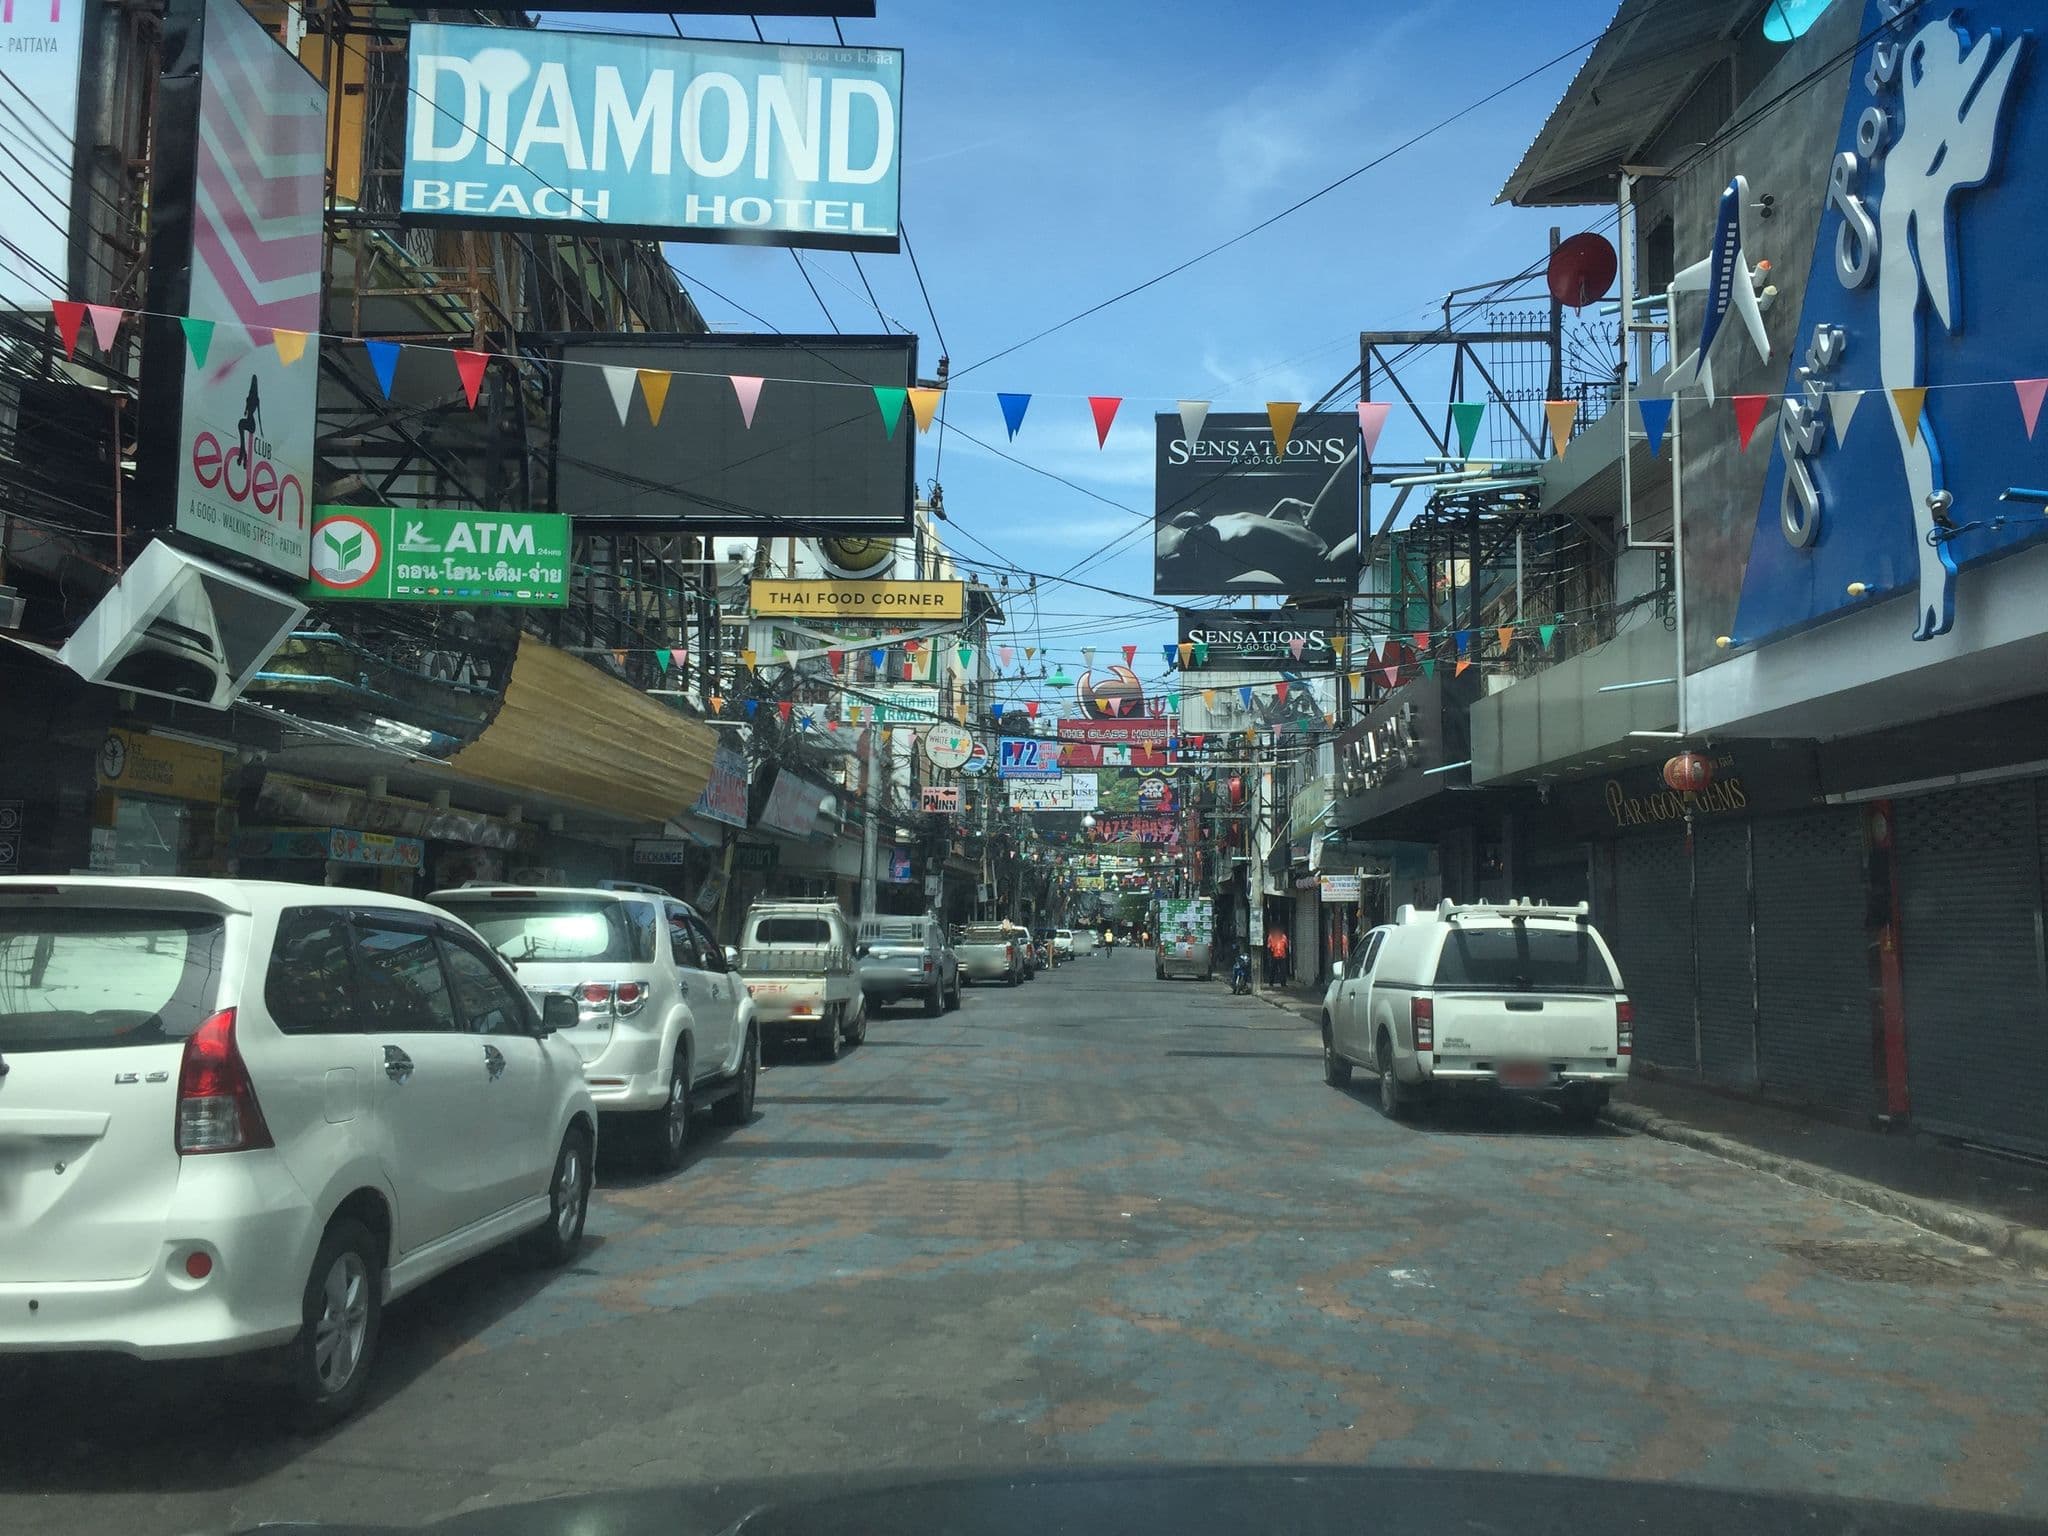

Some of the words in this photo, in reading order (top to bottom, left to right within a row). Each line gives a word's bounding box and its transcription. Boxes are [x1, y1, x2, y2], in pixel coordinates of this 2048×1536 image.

[8, 37, 58, 53] PATTAYA
[412, 47, 895, 184] DIAMOND
[412, 180, 609, 219] BEACH
[685, 194, 888, 233] HOTEL
[254, 437, 272, 459] CLUB
[1167, 438, 1345, 465] SENSATONS
[193, 431, 304, 530] eden
[190, 500, 195, 515] A
[197, 502, 217, 523] GOGO
[222, 513, 251, 538] WALKING
[253, 525, 275, 547] STREET
[279, 537, 303, 558] PATTAYA
[444, 522, 535, 555] ATM
[769, 592, 811, 605] THAI
[817, 593, 866, 605] FOOD
[872, 593, 944, 606] CORNER
[1188, 629, 1326, 651] SENSATIONS
[1061, 728, 1085, 739] THE
[1087, 728, 1129, 739] GLASS
[1002, 741, 1038, 766] P72
[1013, 789, 1069, 801] PALACE
[1605, 780, 1688, 826] PARAGON
[1695, 778, 1746, 813] GEMS
